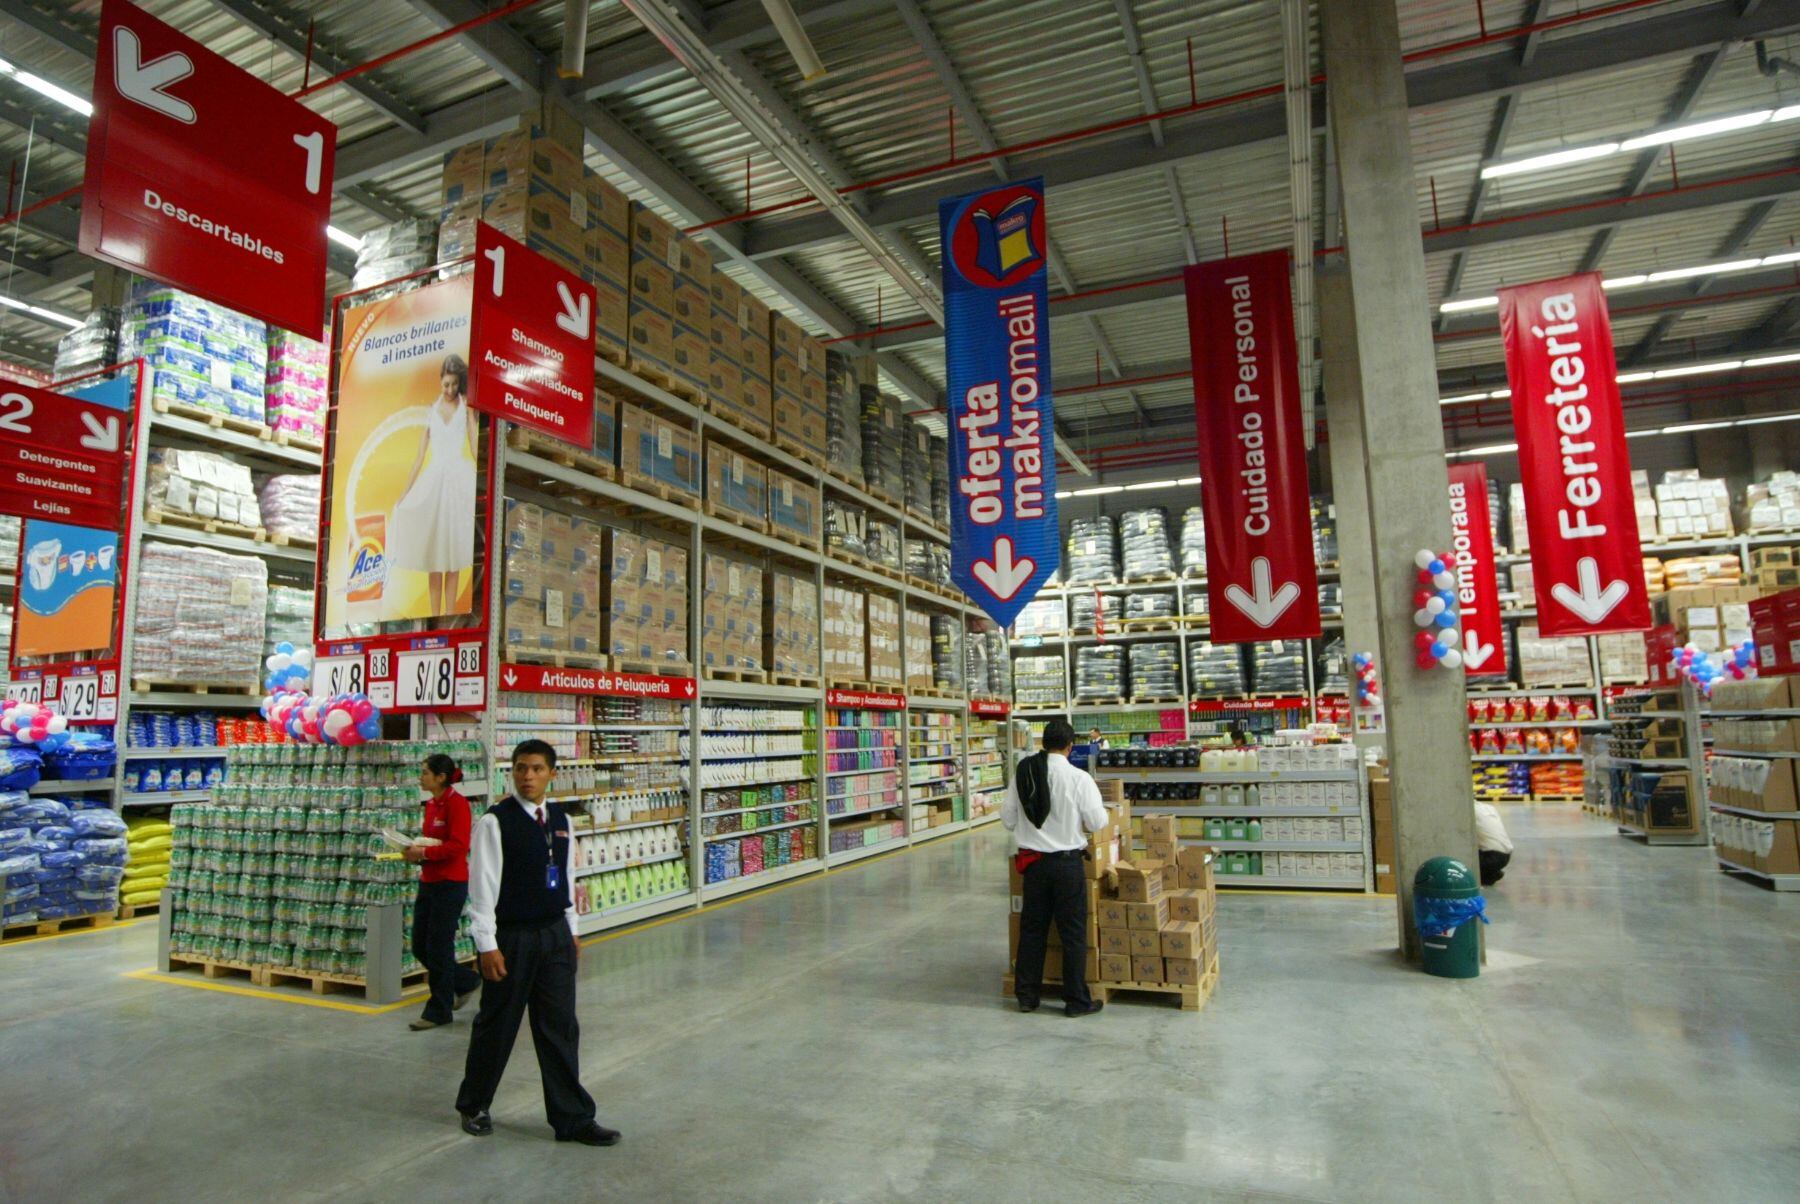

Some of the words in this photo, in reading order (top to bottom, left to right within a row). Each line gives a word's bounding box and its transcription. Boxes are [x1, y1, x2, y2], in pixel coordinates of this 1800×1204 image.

[293, 131, 324, 195] 1
[143, 188, 285, 266] Descartables
[484, 245, 505, 297] 1
[363, 330, 408, 351] Blancos
[410, 314, 468, 340] brillantes
[381, 349, 393, 365] al
[395, 338, 445, 361] instante
[511, 328, 564, 362] Shampoo
[1223, 274, 1259, 404] Personal
[0, 392, 34, 433] 2
[1000, 294, 1043, 520] makromail
[1531, 292, 1607, 540] Ferretería
[19, 448, 97, 474] Detergentes
[959, 380, 1002, 526] oferta
[16, 472, 93, 495] Suavizantes
[1243, 411, 1272, 537] Cuidado
[350, 548, 382, 579] Ace
[349, 663, 361, 693] 8
[372, 655, 387, 676] 88
[437, 657, 451, 700] 8
[460, 649, 478, 671] 88
[541, 671, 595, 689] Artículos
[598, 675, 612, 689] de
[615, 674, 670, 695] Peluquería
[72, 683, 95, 716] 29
[102, 675, 115, 694] 60
[836, 692, 860, 705] Shampoo
[1223, 701, 1252, 709] Cuidado
